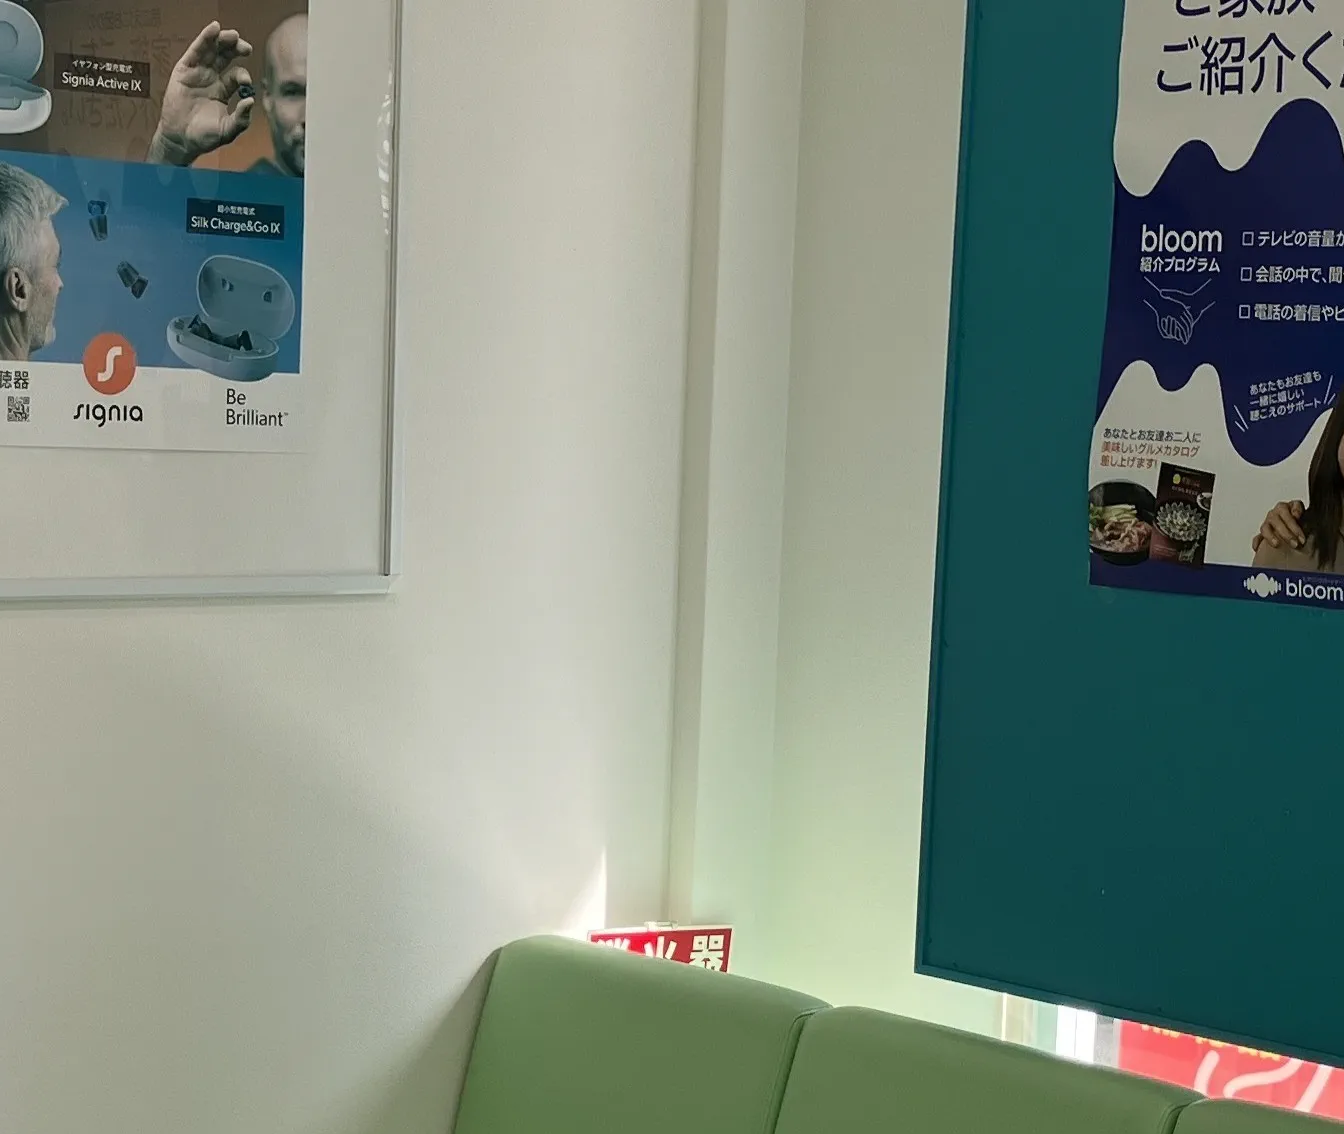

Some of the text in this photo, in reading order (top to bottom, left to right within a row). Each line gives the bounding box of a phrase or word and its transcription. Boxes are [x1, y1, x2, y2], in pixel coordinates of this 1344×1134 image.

[61, 72, 142, 92] Signia Active IX
[191, 216, 281, 234] Silk Charge&Go IX
[1141, 223, 1223, 253] bloom
[1140, 256, 1221, 274] 紹介プログラム
[226, 388, 246, 405] Be
[73, 404, 144, 427] signia
[1103, 428, 1202, 443] あなたとお友達お二人に
[1101, 441, 1200, 457] 美味しいグルメカタログ
[1285, 579, 1344, 602] bloom
